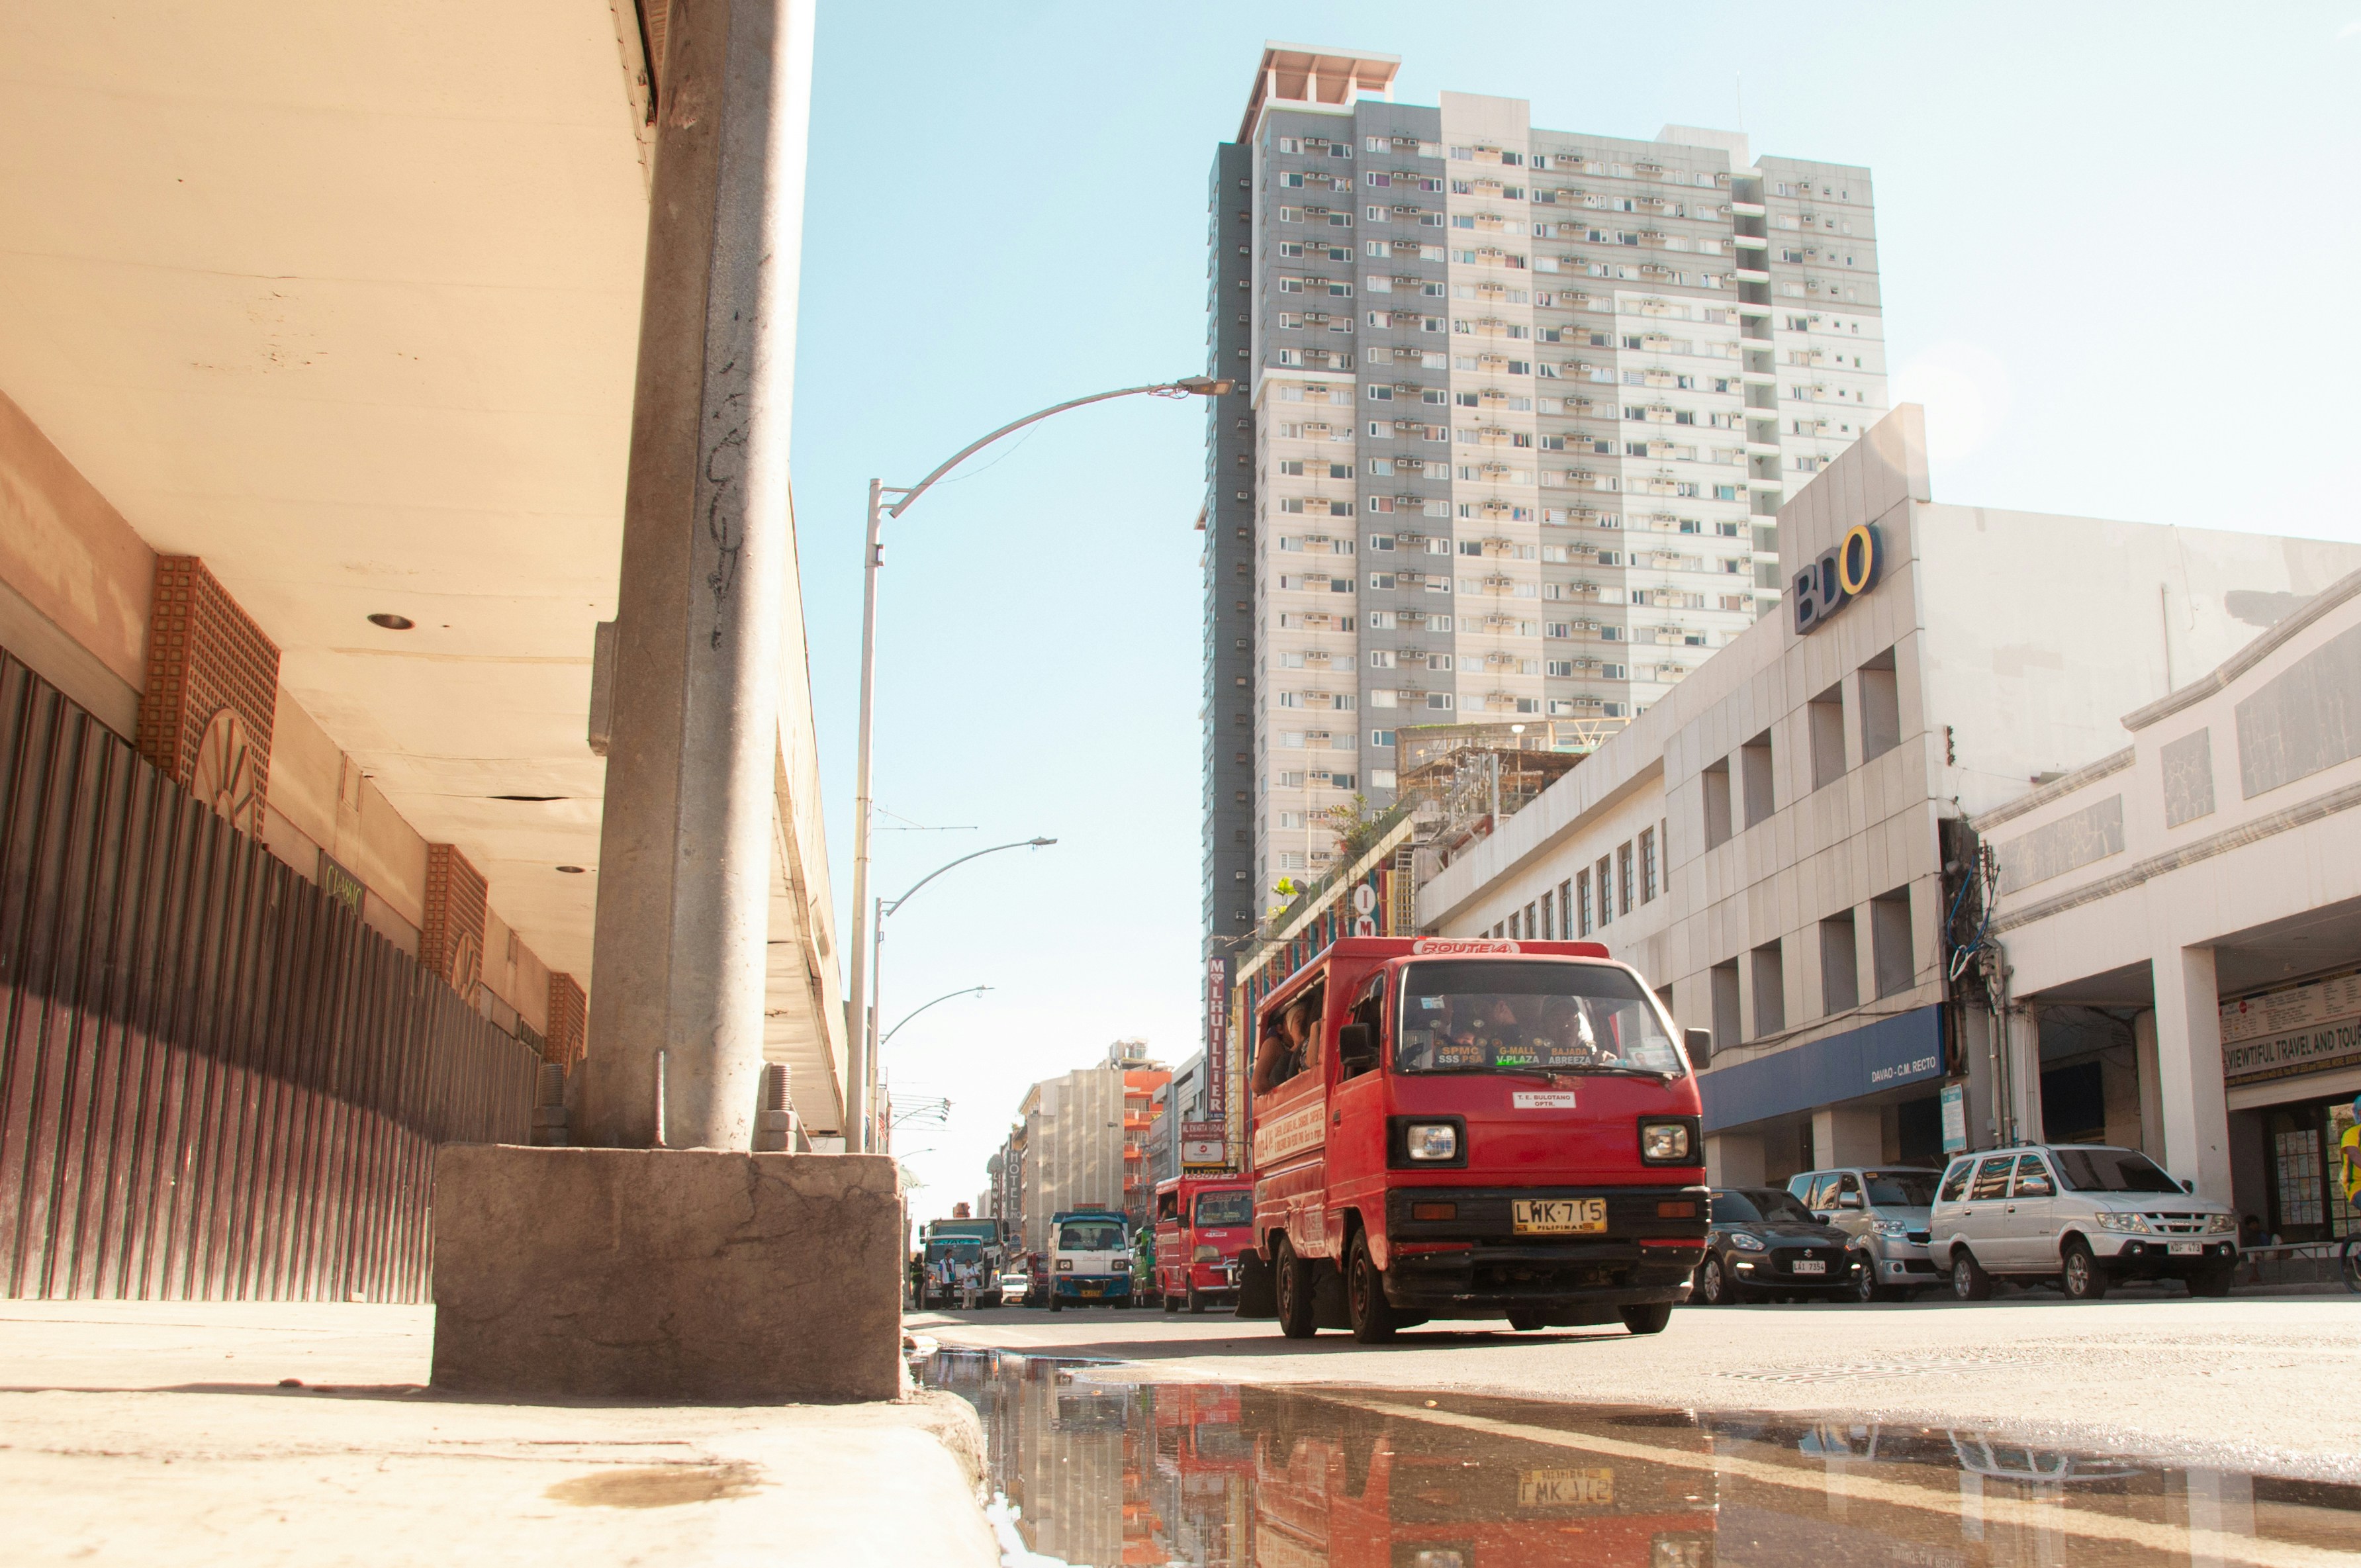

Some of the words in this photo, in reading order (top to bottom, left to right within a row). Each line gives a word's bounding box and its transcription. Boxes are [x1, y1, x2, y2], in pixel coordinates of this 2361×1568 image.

[1792, 524, 1875, 635] BDO
[326, 864, 362, 915] CLASSIC
[1422, 942, 1492, 954] ROUTE
[1210, 960, 1225, 972] M
[1496, 1055, 1540, 1064] V-PLAZA
[1548, 1056, 1591, 1064] ABREEZA
[2227, 1042, 2275, 1069] VIEWTIFUL
[2276, 1035, 2311, 1060] TRAVEL
[2313, 1031, 2335, 1053] AND
[1872, 1067, 1893, 1083] DAVAO
[1898, 1062, 1912, 1076] C.M.
[1912, 1056, 1936, 1074] RECTO
[1009, 1152, 1019, 1211] HOTEL
